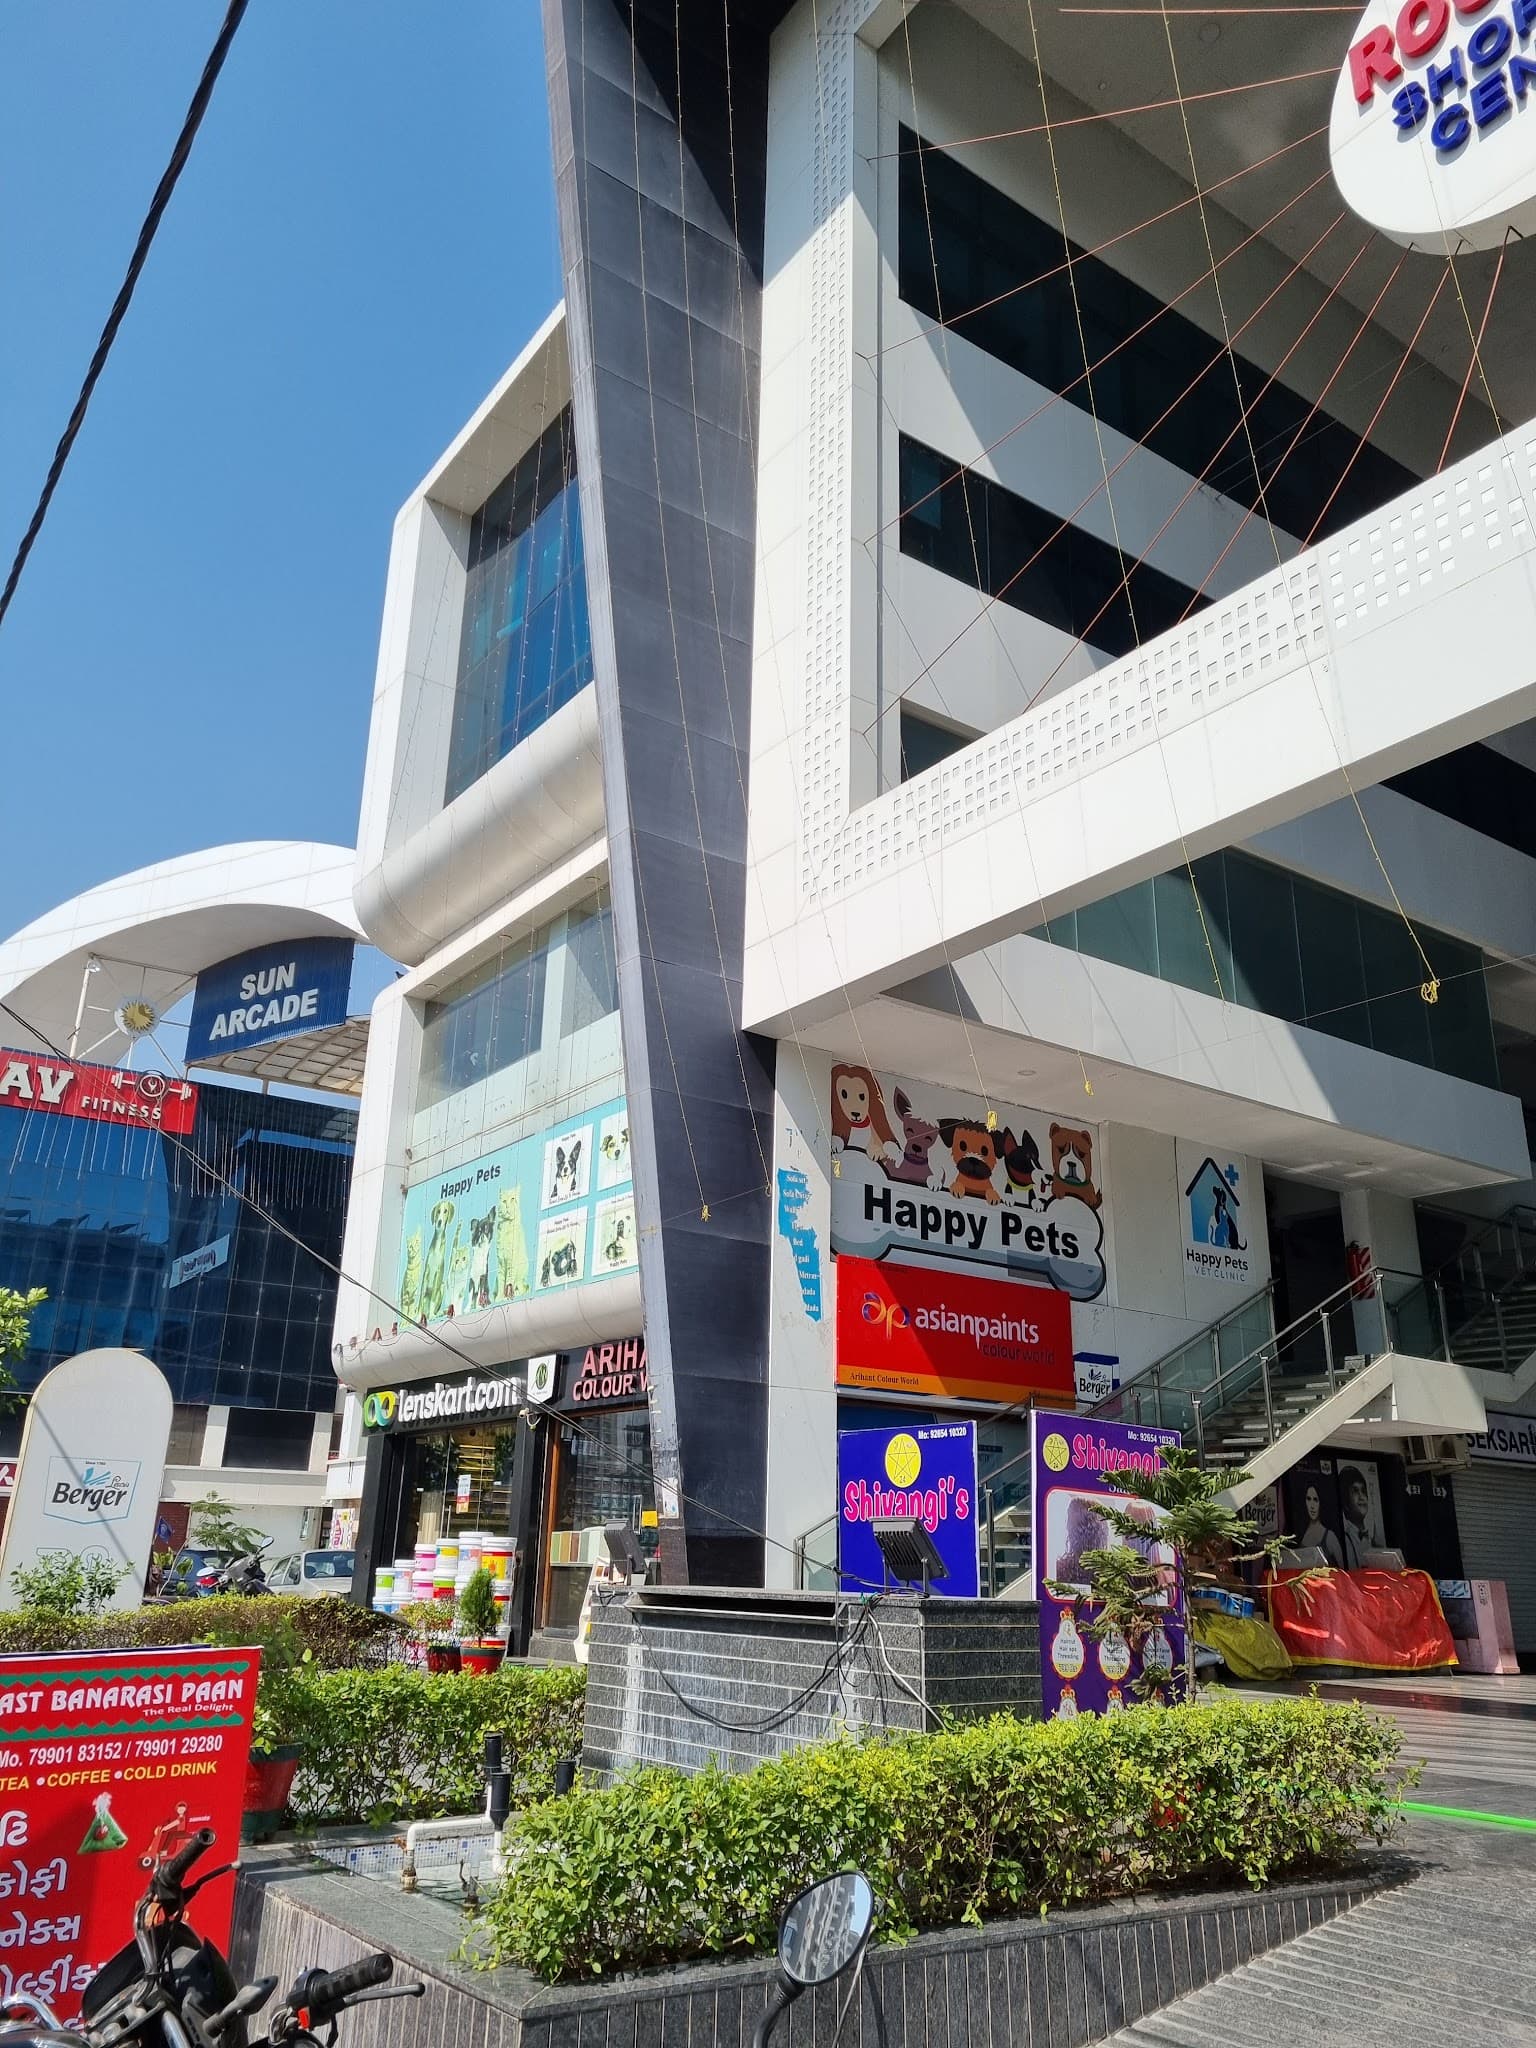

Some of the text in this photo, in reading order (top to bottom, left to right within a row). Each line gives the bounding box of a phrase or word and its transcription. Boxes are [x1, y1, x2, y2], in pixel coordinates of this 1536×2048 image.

[1348, 0, 1493, 105] RO
[239, 961, 296, 1001] SUN
[208, 988, 319, 1041] ARCADE
[81, 1095, 162, 1121] FITNESS
[440, 1163, 501, 1199] Happy Pets
[863, 1183, 1080, 1259] Happy Pets
[1186, 1247, 1249, 1271] Happy Pets
[1194, 1266, 1246, 1282] VET CLINIC
[914, 1302, 1040, 1350] asianpaints
[982, 1340, 1020, 1361] colour
[572, 1373, 633, 1402] COLOUR
[850, 1371, 919, 1385] Arihant Colour World
[1080, 1377, 1111, 1399] Berger
[397, 1375, 521, 1423] lenskart.com
[1072, 1433, 1161, 1482] Shivangi
[52, 1482, 128, 1512] Berger
[843, 1475, 969, 1534] Shivangi's
[1244, 1502, 1276, 1527] Berger
[0, 1678, 244, 1716] AST BANARASI PAAN
[143, 1702, 234, 1718] The Real Delight
[29, 1747, 72, 1767] 79901
[77, 1741, 123, 1763] 83152
[125, 1740, 132, 1759] /
[135, 1738, 176, 1758] 79901
[181, 1734, 223, 1755] 29280
[0, 1760, 218, 1792] TEA COFFEE COLD DRINK
